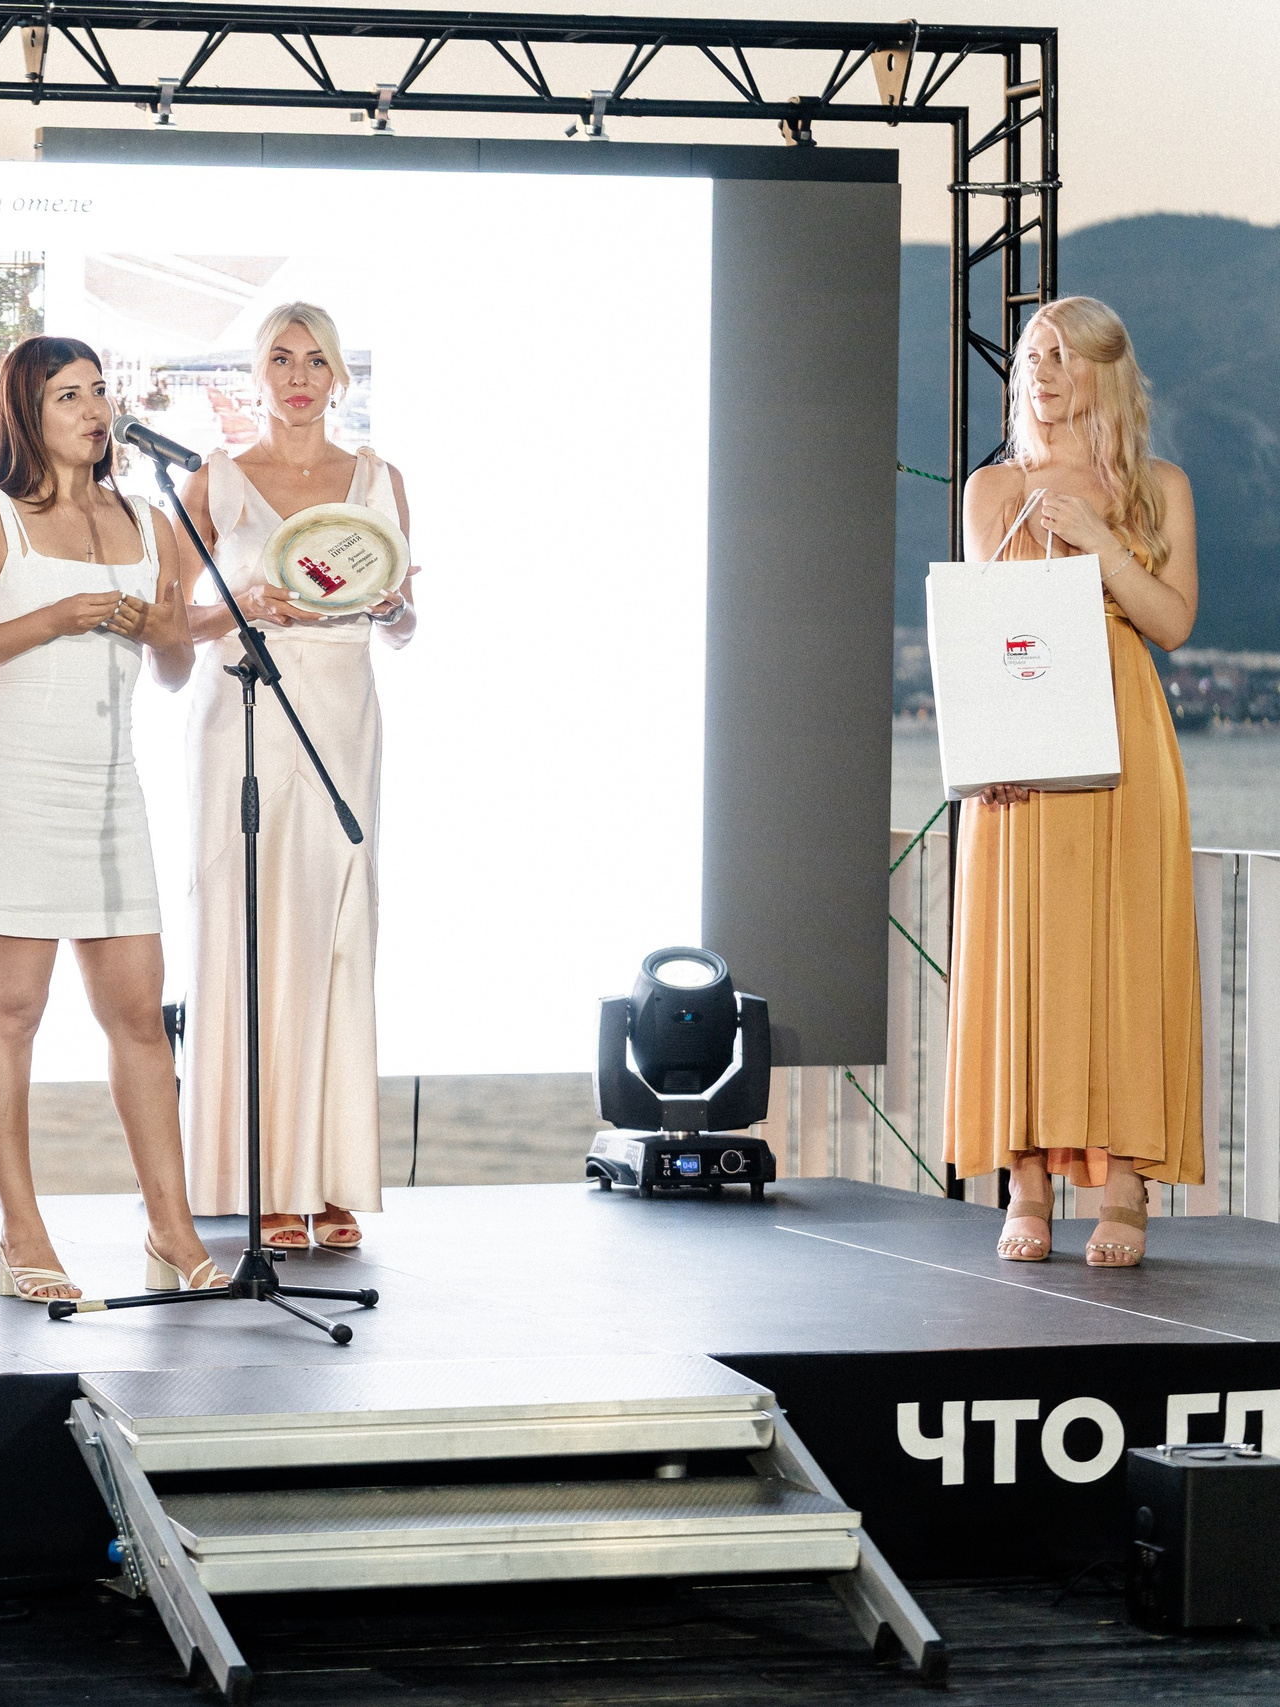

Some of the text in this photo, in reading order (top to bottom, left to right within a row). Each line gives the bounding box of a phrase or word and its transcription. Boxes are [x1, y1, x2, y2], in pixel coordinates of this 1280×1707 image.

[12, 197, 93, 213] отеле
[331, 536, 362, 558] ПРЕМИЯ
[682, 1161, 698, 1169] 049
[896, 1396, 1125, 1486] ЧТО
